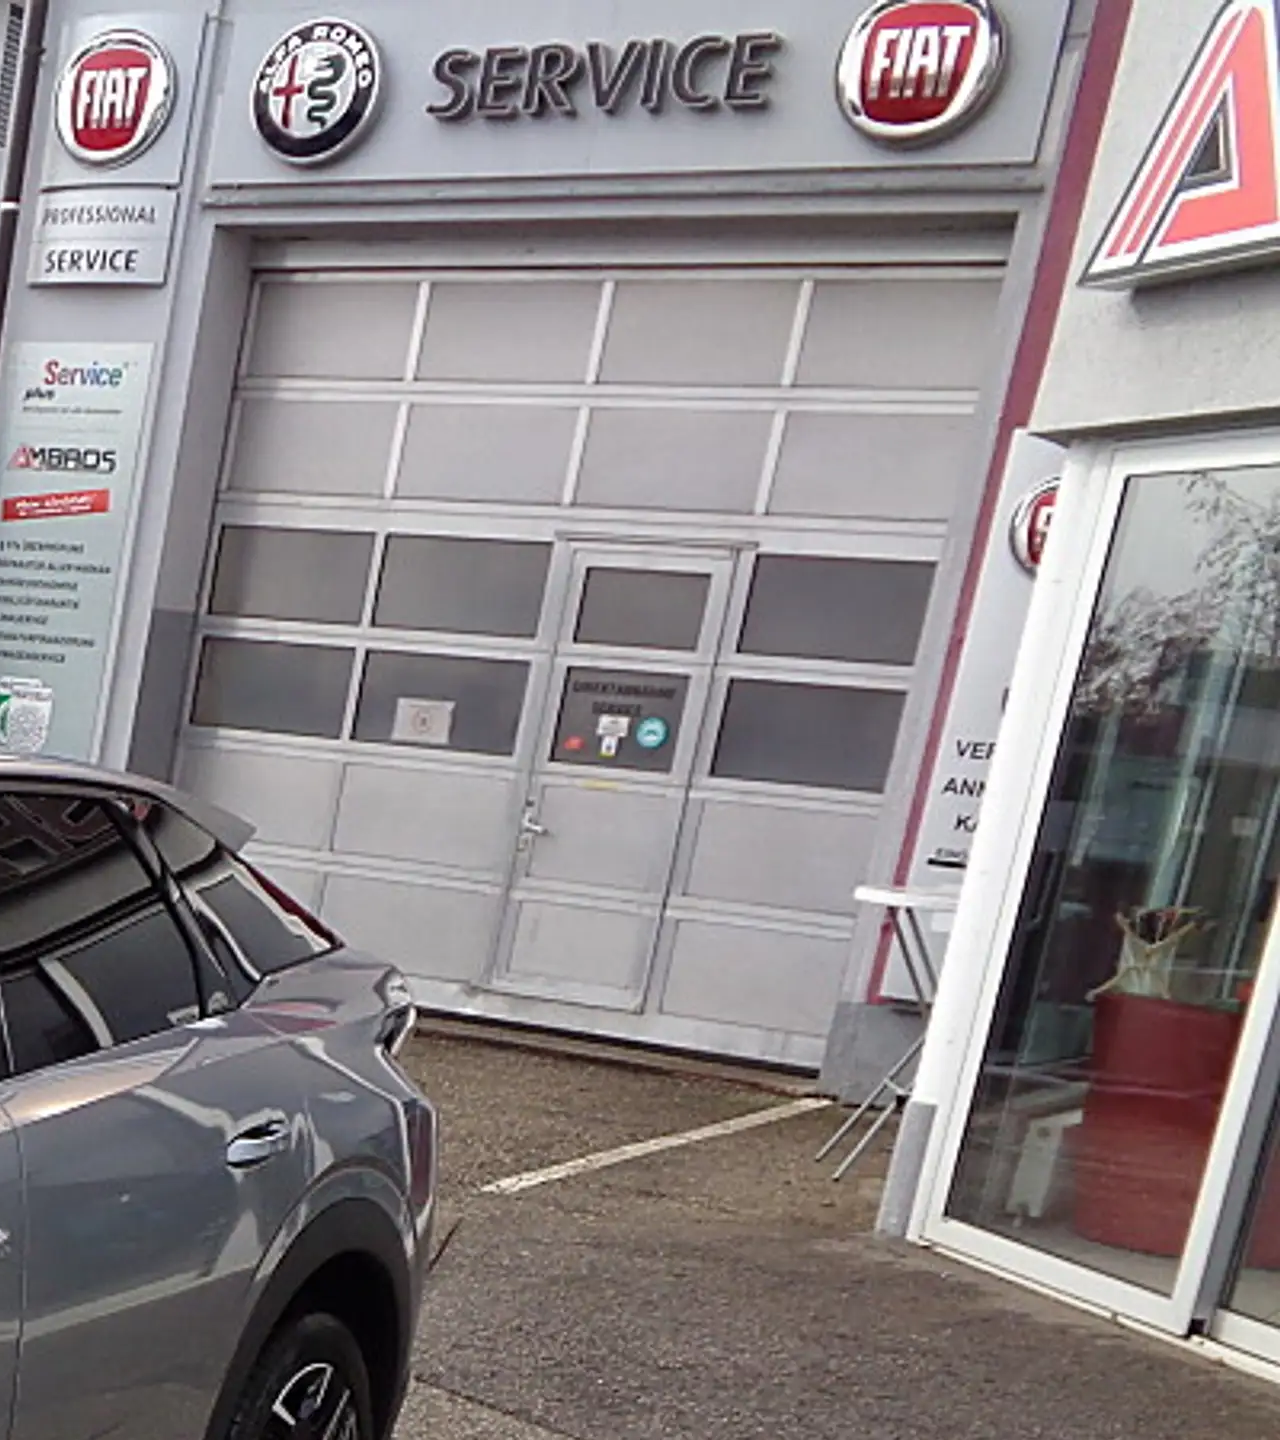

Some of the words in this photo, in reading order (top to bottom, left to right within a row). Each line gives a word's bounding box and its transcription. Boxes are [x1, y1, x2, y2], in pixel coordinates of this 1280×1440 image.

[259, 35, 302, 94] ALFA
[312, 25, 373, 89] ROMEO
[424, 31, 778, 119] SERVICE
[868, 25, 972, 100] FIAT
[76, 66, 150, 130] FIAT
[42, 205, 156, 226] PROFESSIONAL
[45, 249, 140, 274] SERVICE
[43, 358, 123, 387] Service
[6, 443, 117, 475] AMBROS
